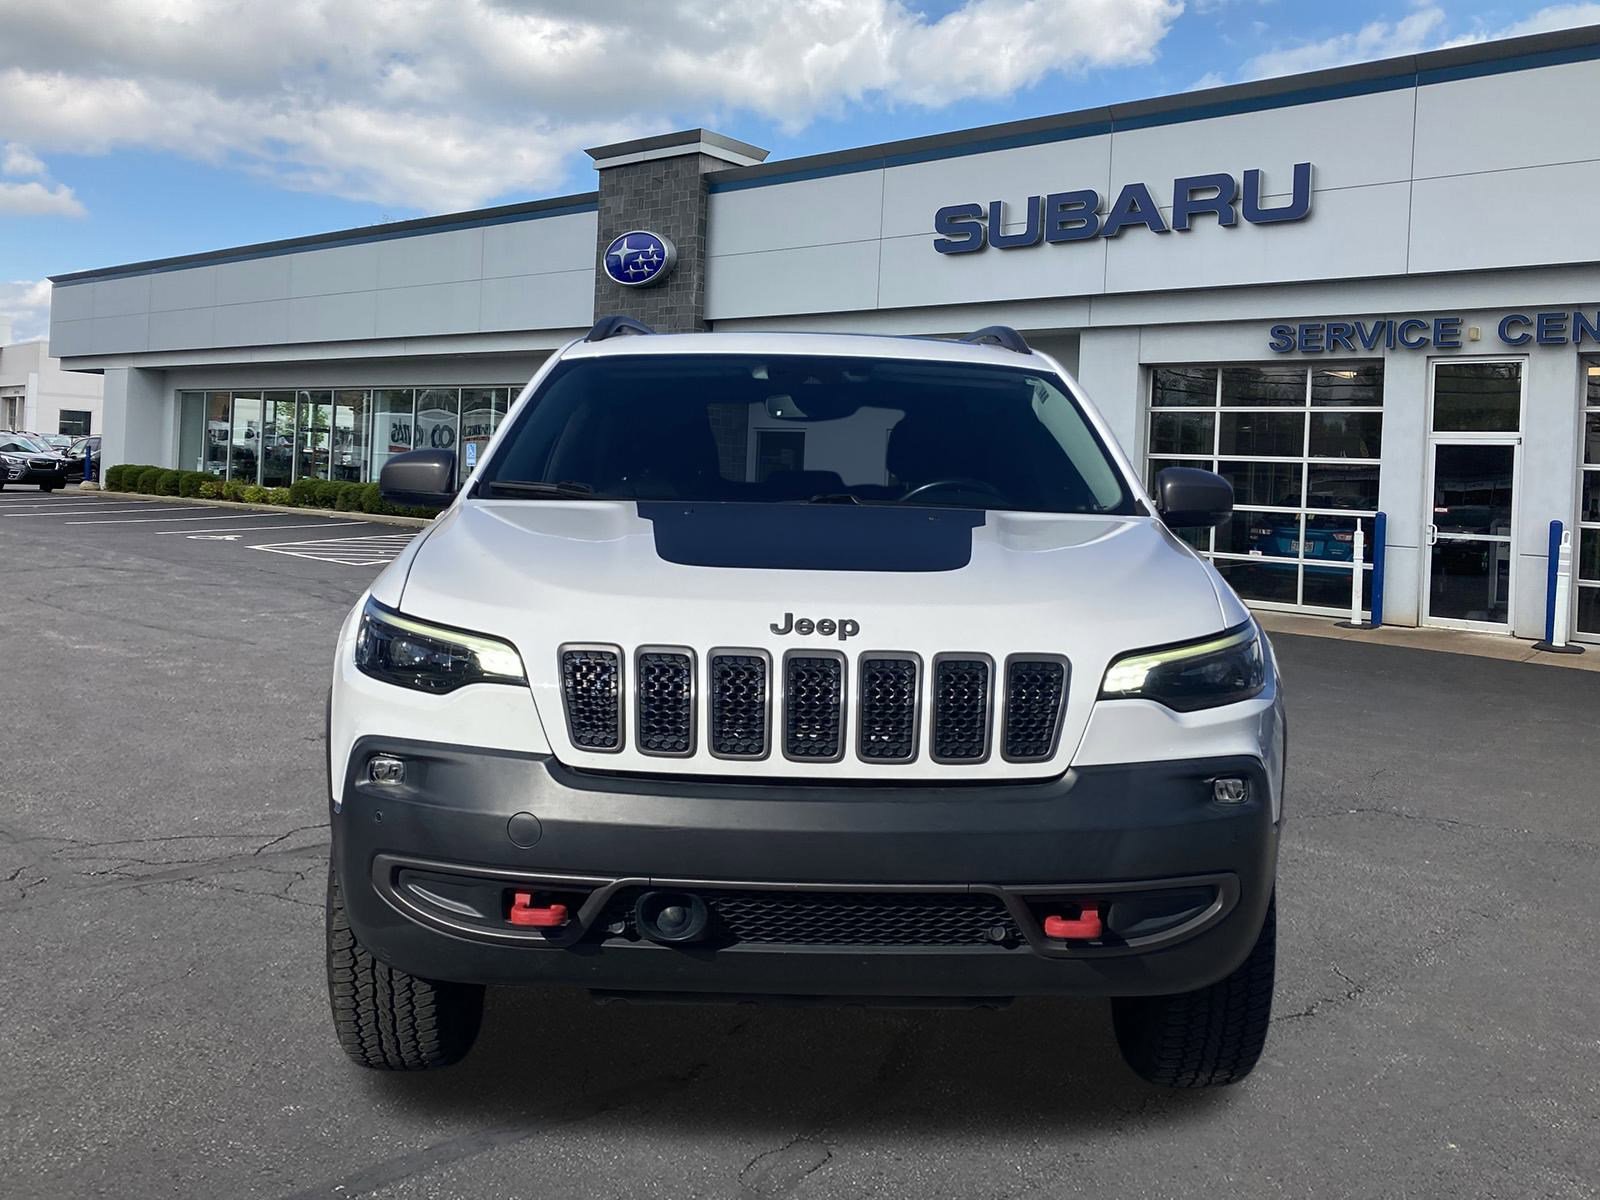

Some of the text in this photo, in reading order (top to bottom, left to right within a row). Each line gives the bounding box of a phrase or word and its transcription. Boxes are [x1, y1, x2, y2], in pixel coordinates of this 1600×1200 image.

[933, 162, 1313, 255] SUBARU
[1268, 310, 1600, 352] SERVICE CEN
[769, 612, 860, 641] Jeep
